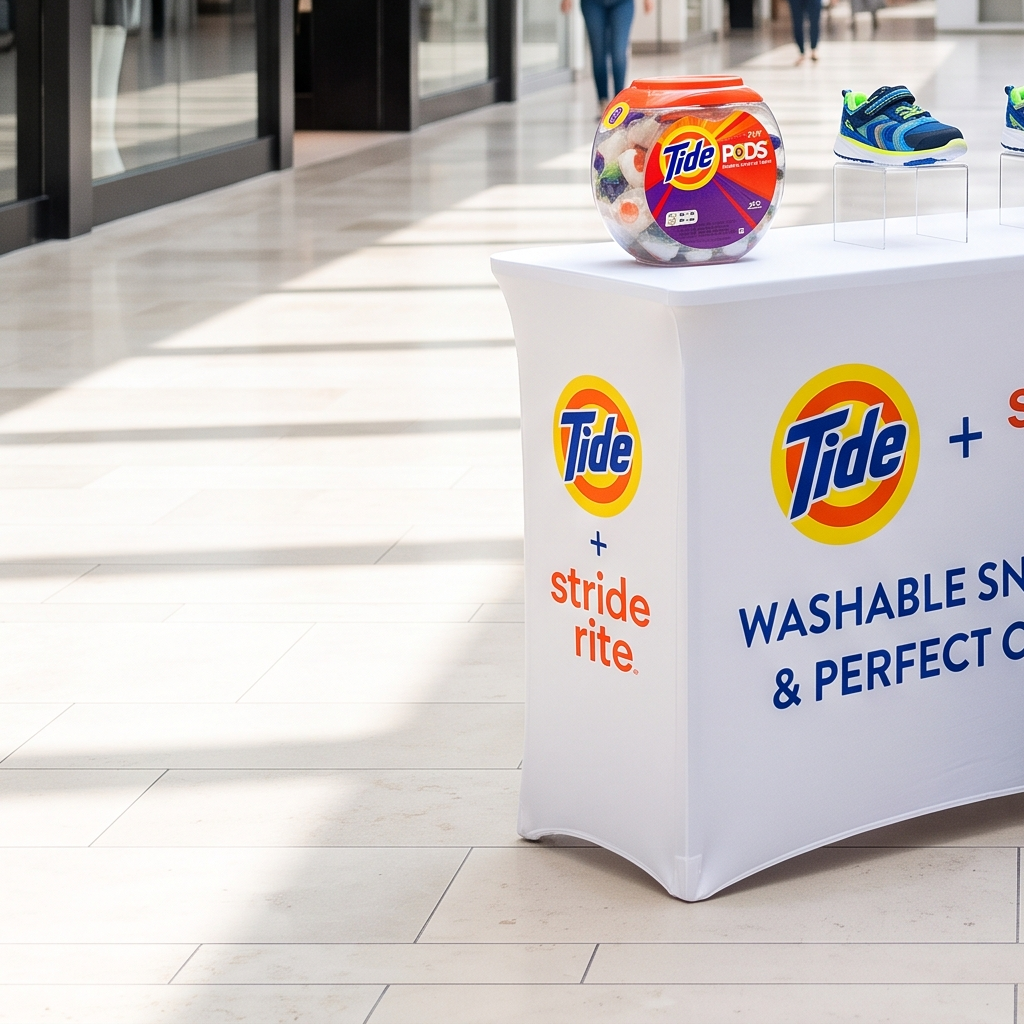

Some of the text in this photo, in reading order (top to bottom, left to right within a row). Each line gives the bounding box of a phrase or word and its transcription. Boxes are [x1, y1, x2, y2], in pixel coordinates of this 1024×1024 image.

[663, 138, 716, 184] Tide
[722, 140, 769, 163] PODS
[559, 410, 634, 483] Tide
[783, 404, 908, 522] Tide
[551, 568, 650, 627] stride
[739, 567, 966, 648] WASHABLE
[773, 668, 801, 710] &
[816, 627, 992, 701] PERFECT
